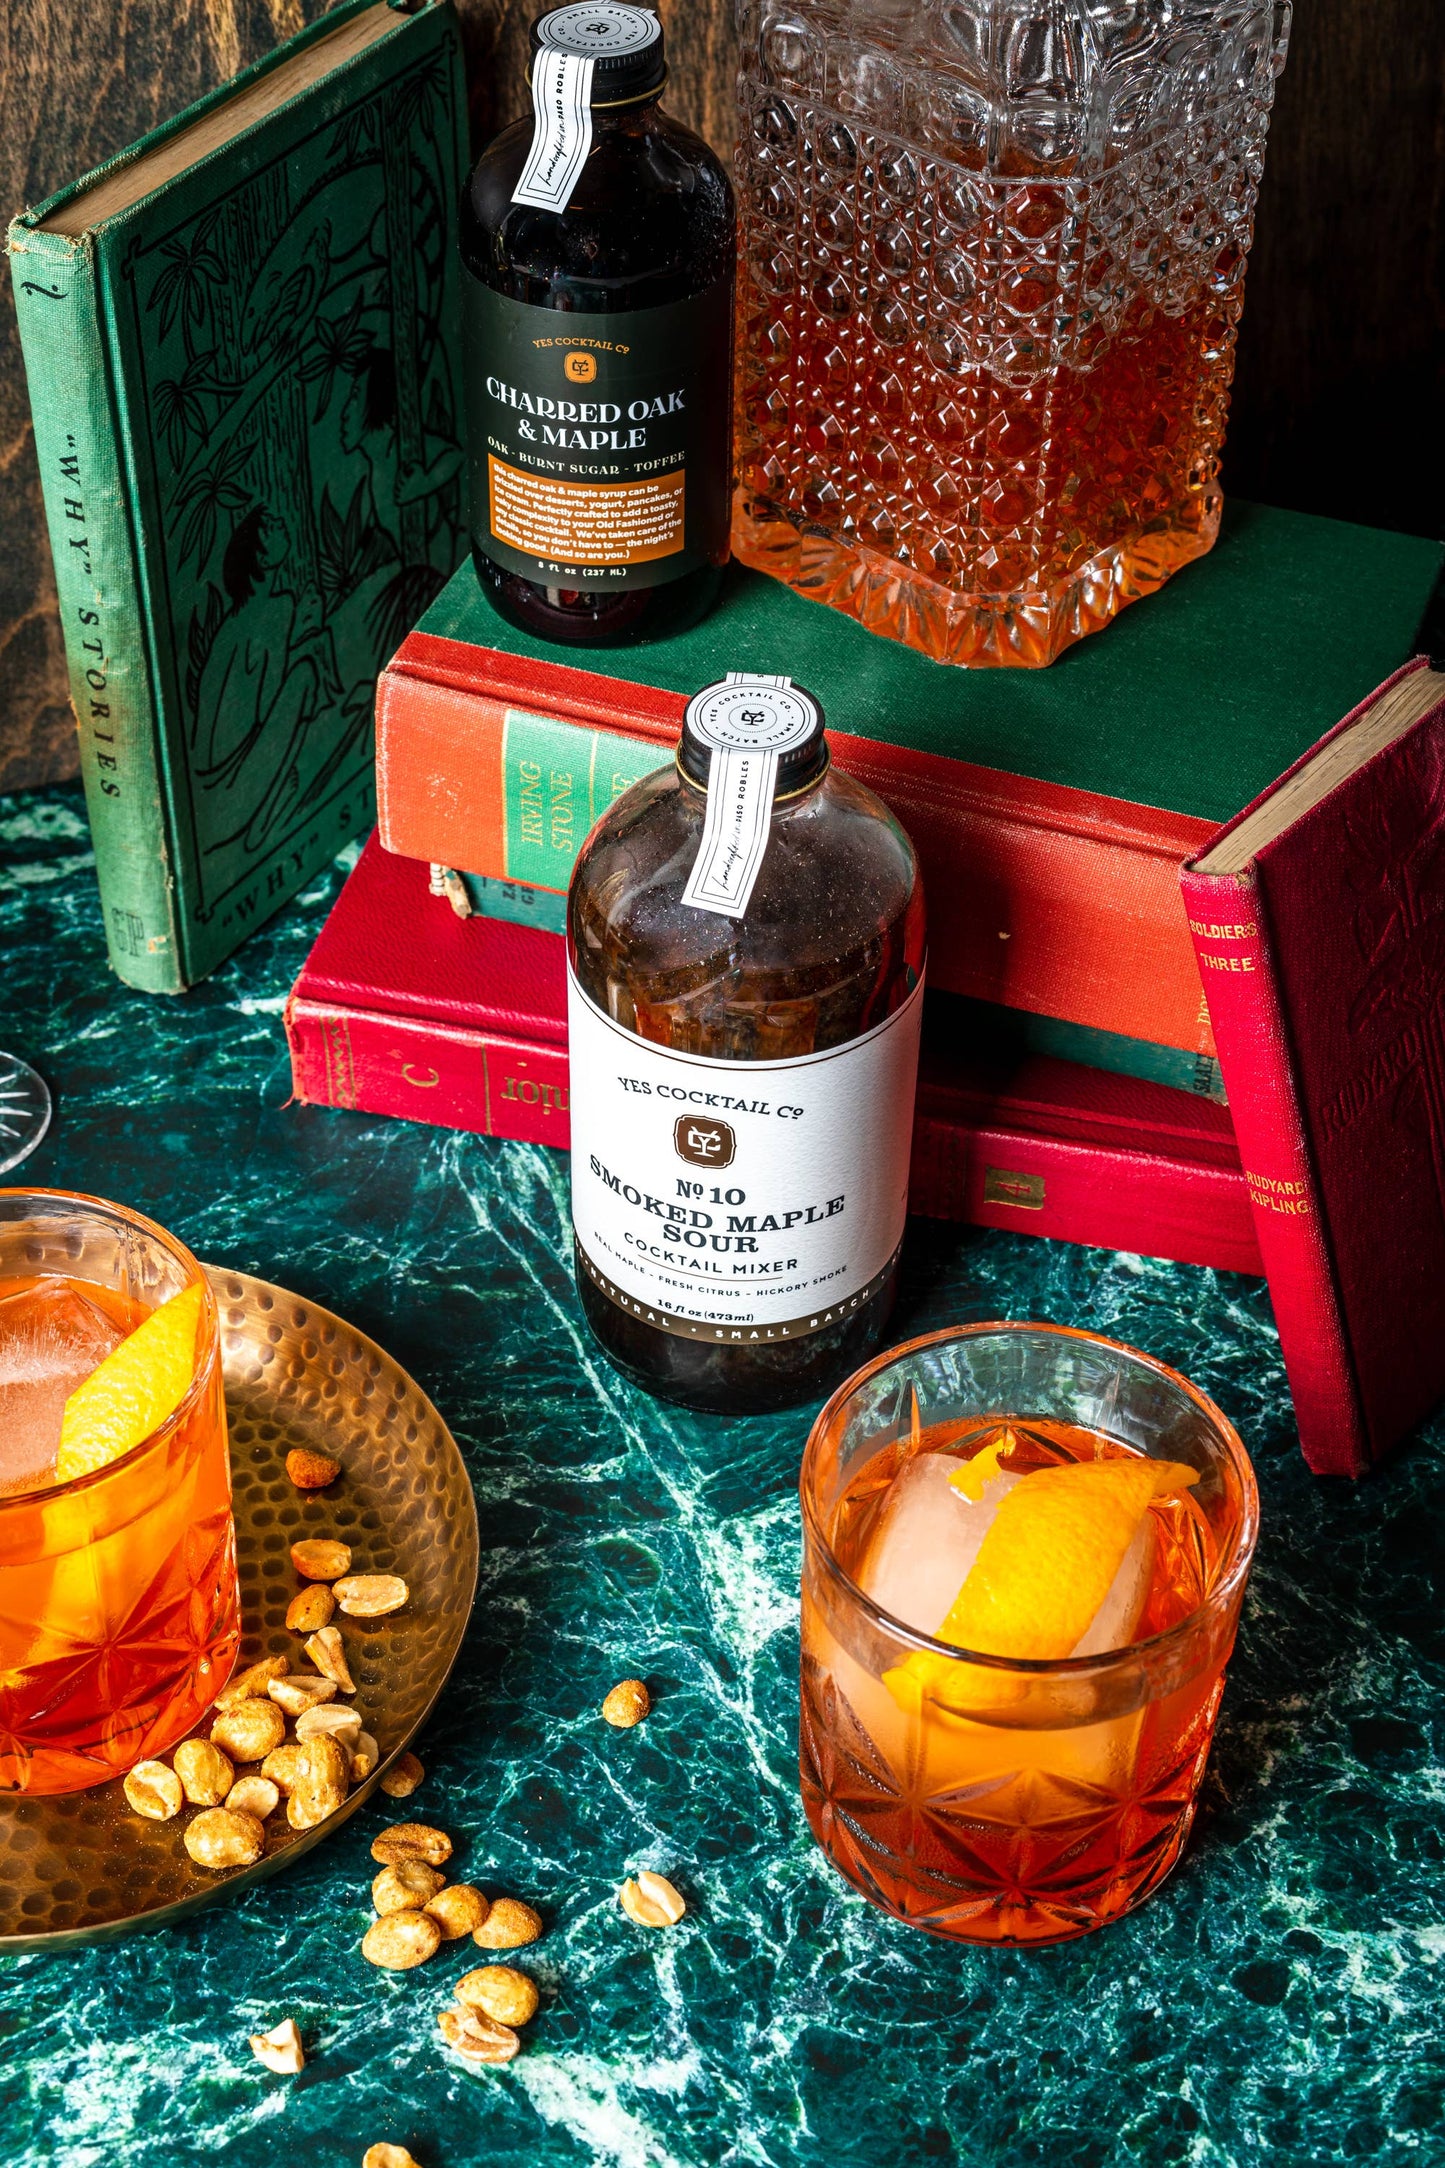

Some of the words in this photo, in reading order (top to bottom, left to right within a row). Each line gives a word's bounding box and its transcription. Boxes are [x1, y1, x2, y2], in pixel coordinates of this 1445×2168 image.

[567, 9, 599, 20] SMALL
[608, 10, 637, 23] BATCH
[567, 37, 620, 47] COCKTAIL
[556, 53, 568, 94] ROBLES
[555, 100, 565, 120] PASO
[532, 339, 553, 349] YES
[555, 337, 613, 351] COCKTAIL
[486, 376, 621, 424] CHARRED
[627, 388, 686, 421] OAK
[517, 418, 538, 441] &
[541, 425, 647, 450] MAPLE
[487, 436, 509, 455] OAK
[519, 452, 565, 472] BURNT
[569, 464, 620, 475] SUGAR
[633, 451, 686, 472] TOFFEE
[493, 463, 507, 477] this
[507, 471, 539, 489] charred
[539, 484, 556, 494] oak
[558, 486, 565, 495] &
[567, 488, 598, 498] maple
[599, 490, 627, 499] syrup
[628, 488, 645, 497] can
[647, 484, 659, 493] be
[494, 475, 524, 494] drizzled
[524, 490, 544, 500] over
[545, 494, 587, 508] desserts,
[589, 500, 625, 510] yogurt,
[627, 491, 672, 508] pancakes,
[673, 487, 684, 496] or
[494, 484, 505, 495] ice
[505, 491, 531, 507] cream.
[533, 501, 573, 518] Perfectly
[574, 509, 609, 518] crafted
[611, 510, 621, 518] to
[622, 508, 641, 517] add
[642, 507, 649, 515] a
[649, 500, 678, 513] toasty,
[494, 495, 512, 509] oaky
[512, 505, 559, 525] complexity
[560, 518, 571, 527] to
[572, 520, 595, 529] your
[596, 521, 614, 529] Old
[616, 514, 664, 528] Fashioned
[665, 511, 675, 520] or
[495, 505, 508, 518] any
[508, 513, 534, 528] classic
[534, 523, 572, 537] cocktail.
[575, 530, 607, 539] We've
[608, 529, 635, 539] taken
[637, 526, 657, 536] care
[658, 522, 667, 532] of
[668, 518, 682, 528] the
[495, 515, 521, 535] details,
[522, 529, 533, 538] so
[533, 533, 550, 543] you
[551, 536, 578, 548] don't
[578, 540, 602, 549] have
[603, 541, 614, 549] to
[627, 539, 643, 548] the
[643, 531, 674, 545] night's
[495, 524, 523, 545] looking
[523, 541, 549, 553] good.
[550, 546, 574, 557] (And
[574, 549, 586, 558] so
[587, 551, 604, 559] are
[605, 549, 630, 560] you.)
[548, 563, 560, 572] fl
[582, 568, 605, 577] (237
[609, 568, 627, 576] ML)
[78, 608, 120, 797] STORIES
[710, 709, 718, 723] YES
[718, 692, 774, 706] COCKTAIL
[720, 731, 758, 744] BATCH
[766, 722, 794, 742] SMALL
[738, 760, 749, 800] ROBLES
[519, 759, 543, 846] IRVING
[550, 770, 574, 853] STONE
[735, 804, 744, 823] PASO
[1189, 919, 1257, 939] SOLDIERS
[1200, 952, 1255, 972] THREE
[617, 1076, 652, 1094] YES
[656, 1085, 771, 1115] COCKTAIL
[590, 1154, 713, 1229] SMOKED
[726, 1194, 846, 1233] MAPLE
[709, 1187, 746, 1206] 10
[1246, 1170, 1305, 1195] RUDYARD
[1249, 1188, 1309, 1215] KIPLING
[624, 1231, 722, 1274] COCKTAIL
[732, 1258, 798, 1275] MIXER
[662, 1223, 759, 1253] SOUR
[594, 1231, 613, 1253] REAL
[615, 1251, 645, 1274] MAPLE
[658, 1275, 693, 1291] FRESH
[698, 1286, 741, 1297] CITRUS
[756, 1281, 808, 1297] HICKORY
[812, 1264, 848, 1286] SMOKE
[590, 1266, 670, 1327] NATURAL
[715, 1327, 790, 1340] SMALL
[810, 1289, 869, 1328] BATCH
[657, 1299, 673, 1310] 16
[673, 1305, 685, 1315] fl
[688, 1309, 702, 1317] oz
[704, 1309, 754, 1322] (473ml)
